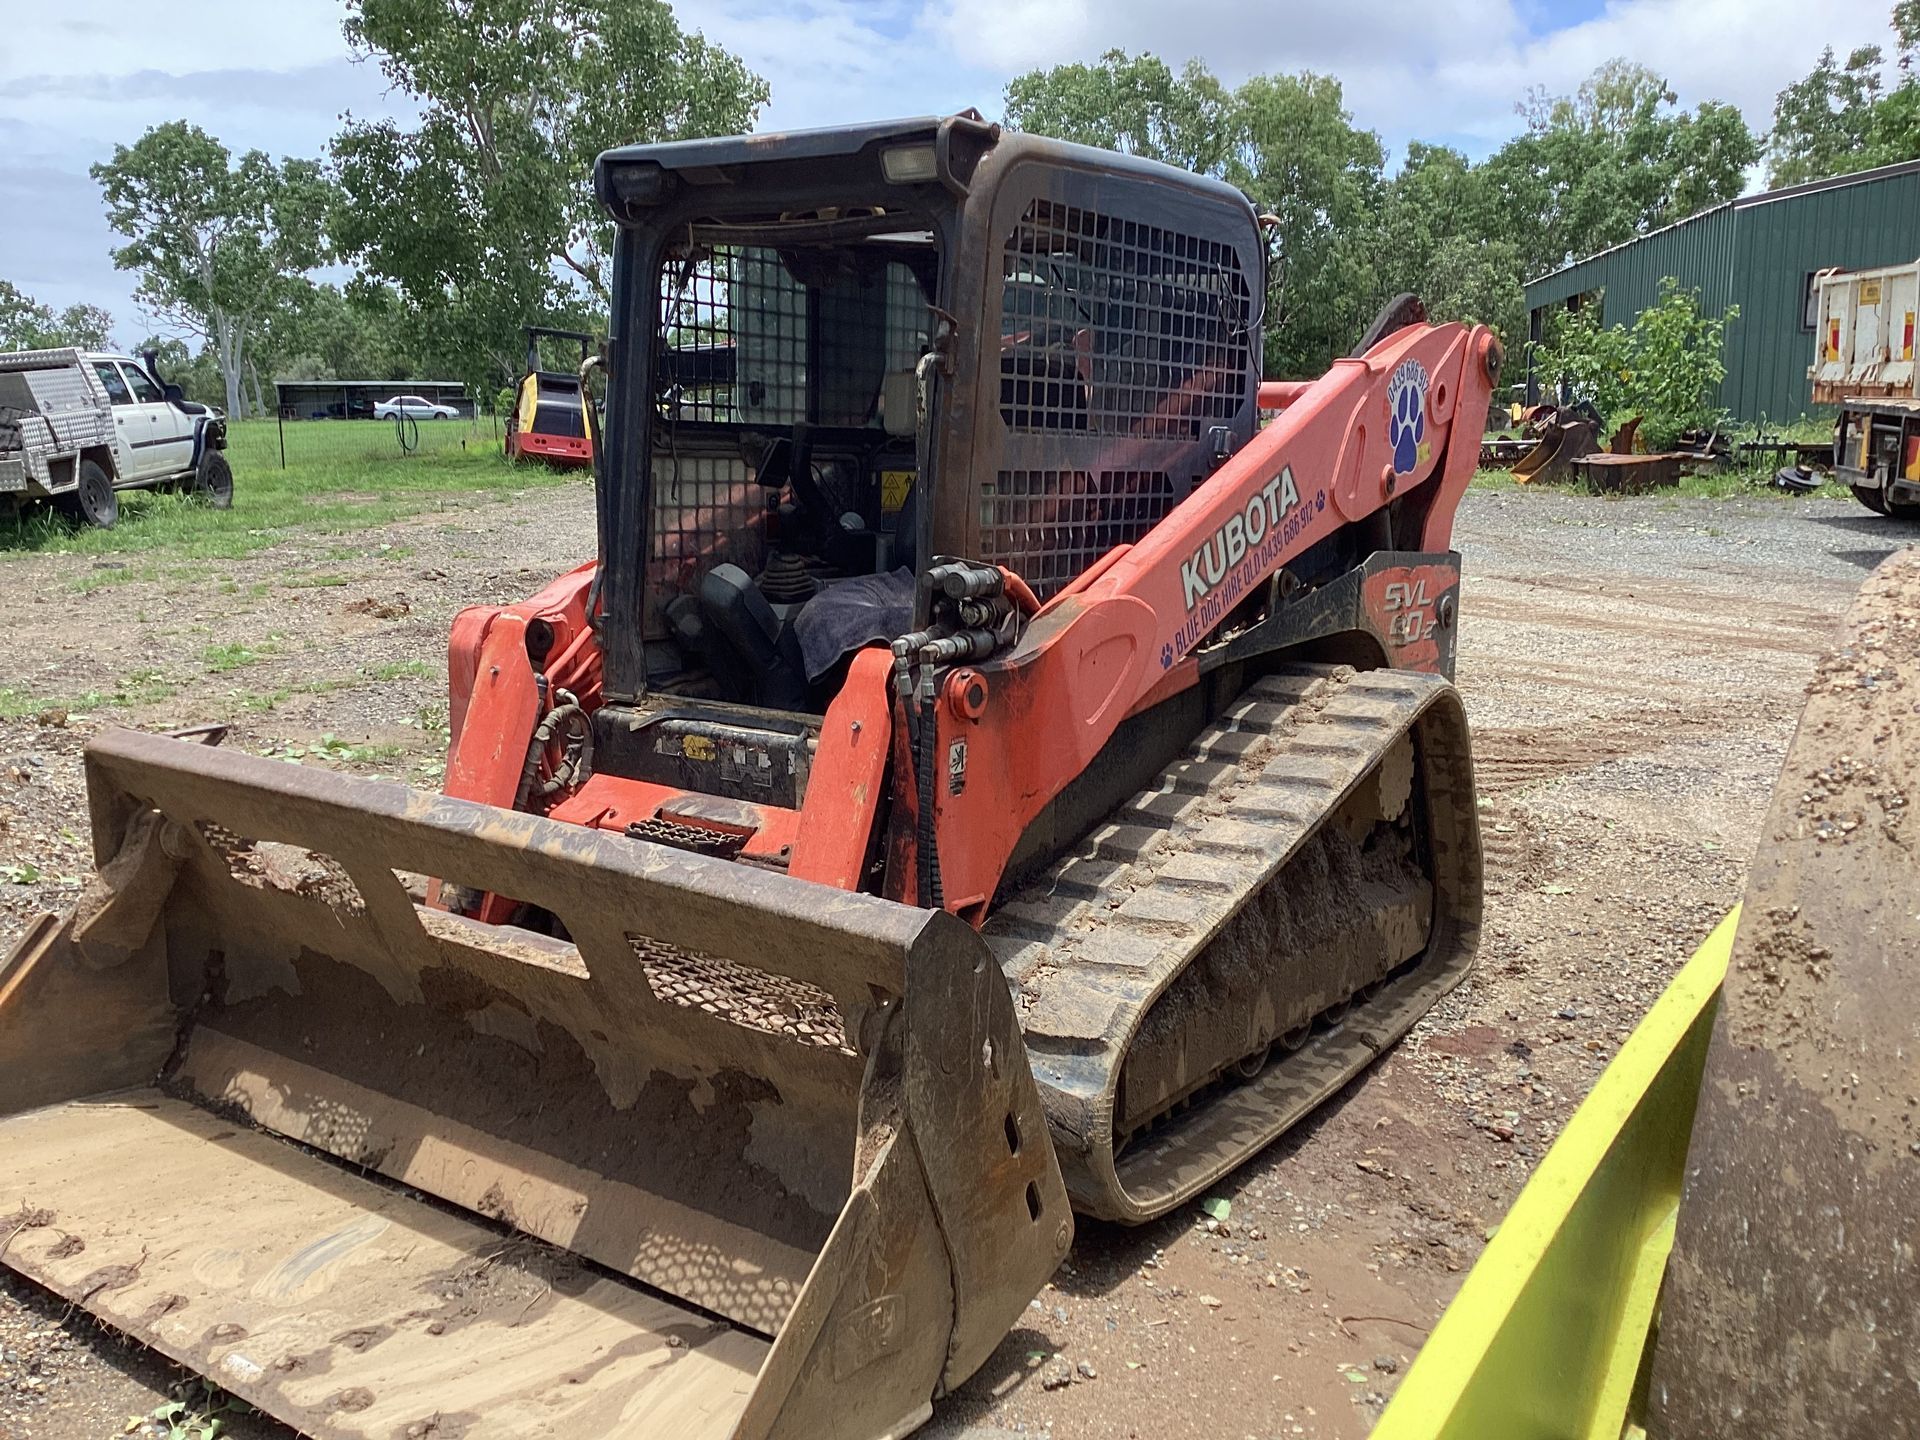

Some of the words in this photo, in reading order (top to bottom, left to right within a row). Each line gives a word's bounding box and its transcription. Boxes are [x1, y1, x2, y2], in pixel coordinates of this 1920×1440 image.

[1388, 363, 1406, 403] 0439
[1406, 359, 1420, 382] 686
[1175, 614, 1201, 656] BLUE
[1200, 592, 1221, 629] DOG
[1221, 569, 1243, 609] HIRE
[1261, 530, 1284, 567] 0439
[1283, 513, 1300, 545] 686
[1300, 500, 1314, 529] 912
[1181, 466, 1300, 612] KUBOTA
[1384, 579, 1432, 612] SVL
